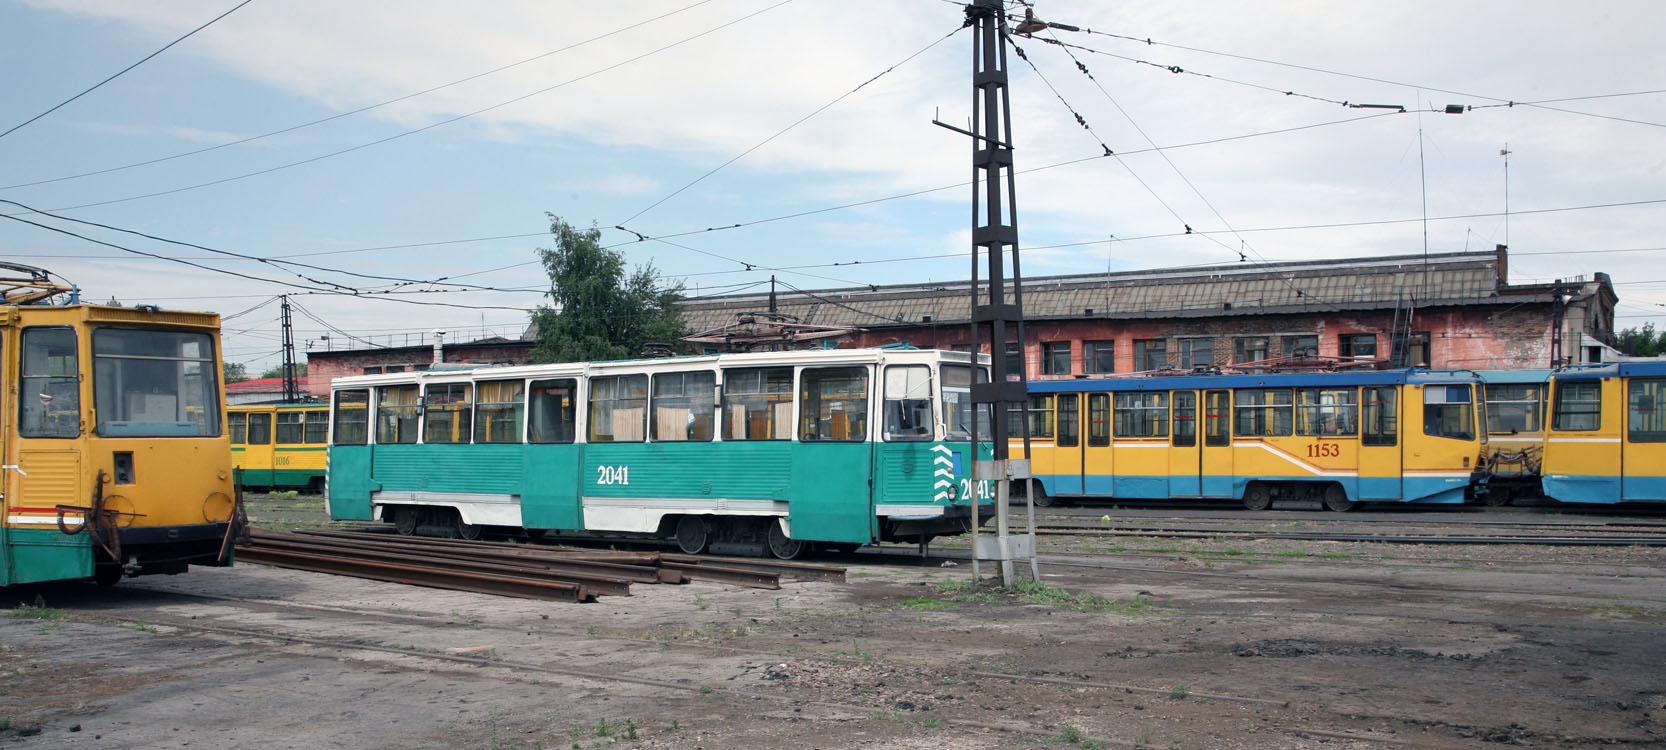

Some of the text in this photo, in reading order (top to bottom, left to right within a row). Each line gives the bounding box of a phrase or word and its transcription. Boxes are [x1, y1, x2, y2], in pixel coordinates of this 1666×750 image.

[1307, 443, 1340, 458] 1153
[275, 455, 290, 466] 1016
[597, 465, 629, 485] 2041
